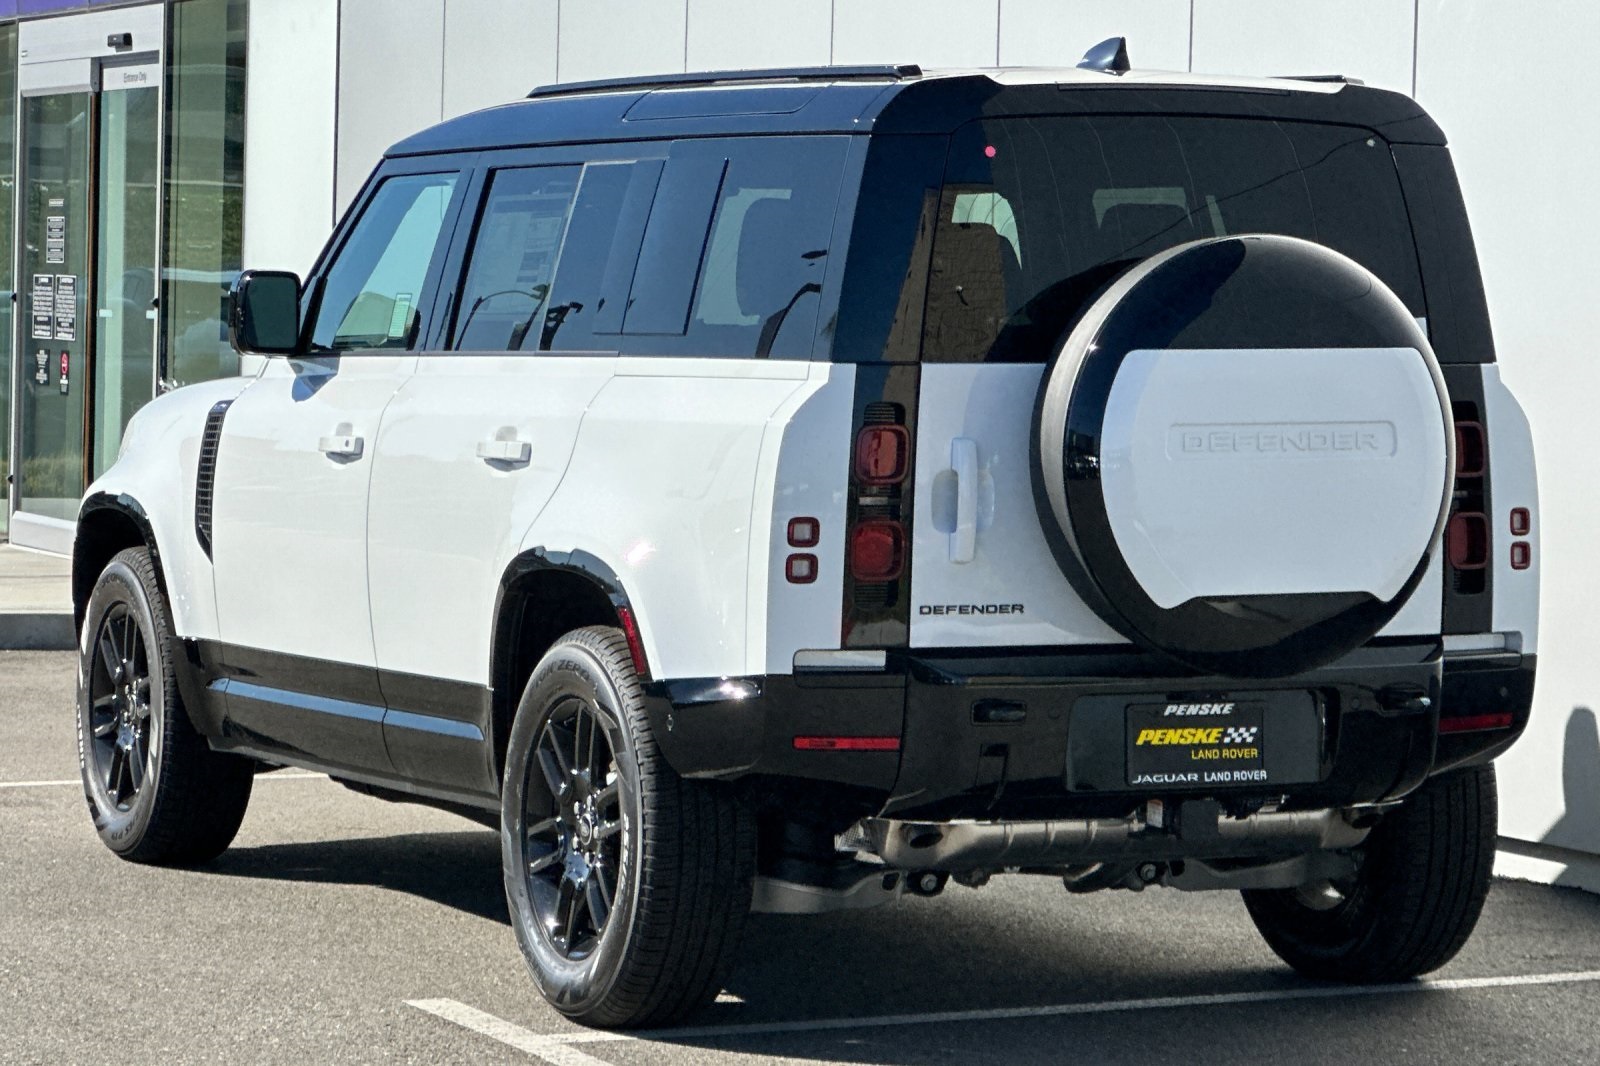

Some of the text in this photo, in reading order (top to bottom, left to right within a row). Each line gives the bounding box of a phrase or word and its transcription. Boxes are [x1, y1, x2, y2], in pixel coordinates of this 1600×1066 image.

[1183, 431, 1379, 453] DEFENDER
[919, 604, 1024, 615] DEFENDER
[1164, 702, 1235, 716] PENSKE
[1136, 728, 1224, 746] PENSKE
[1191, 748, 1258, 760] LAND ROVER
[1132, 770, 1267, 784] JAGUAR LAND ROVER
